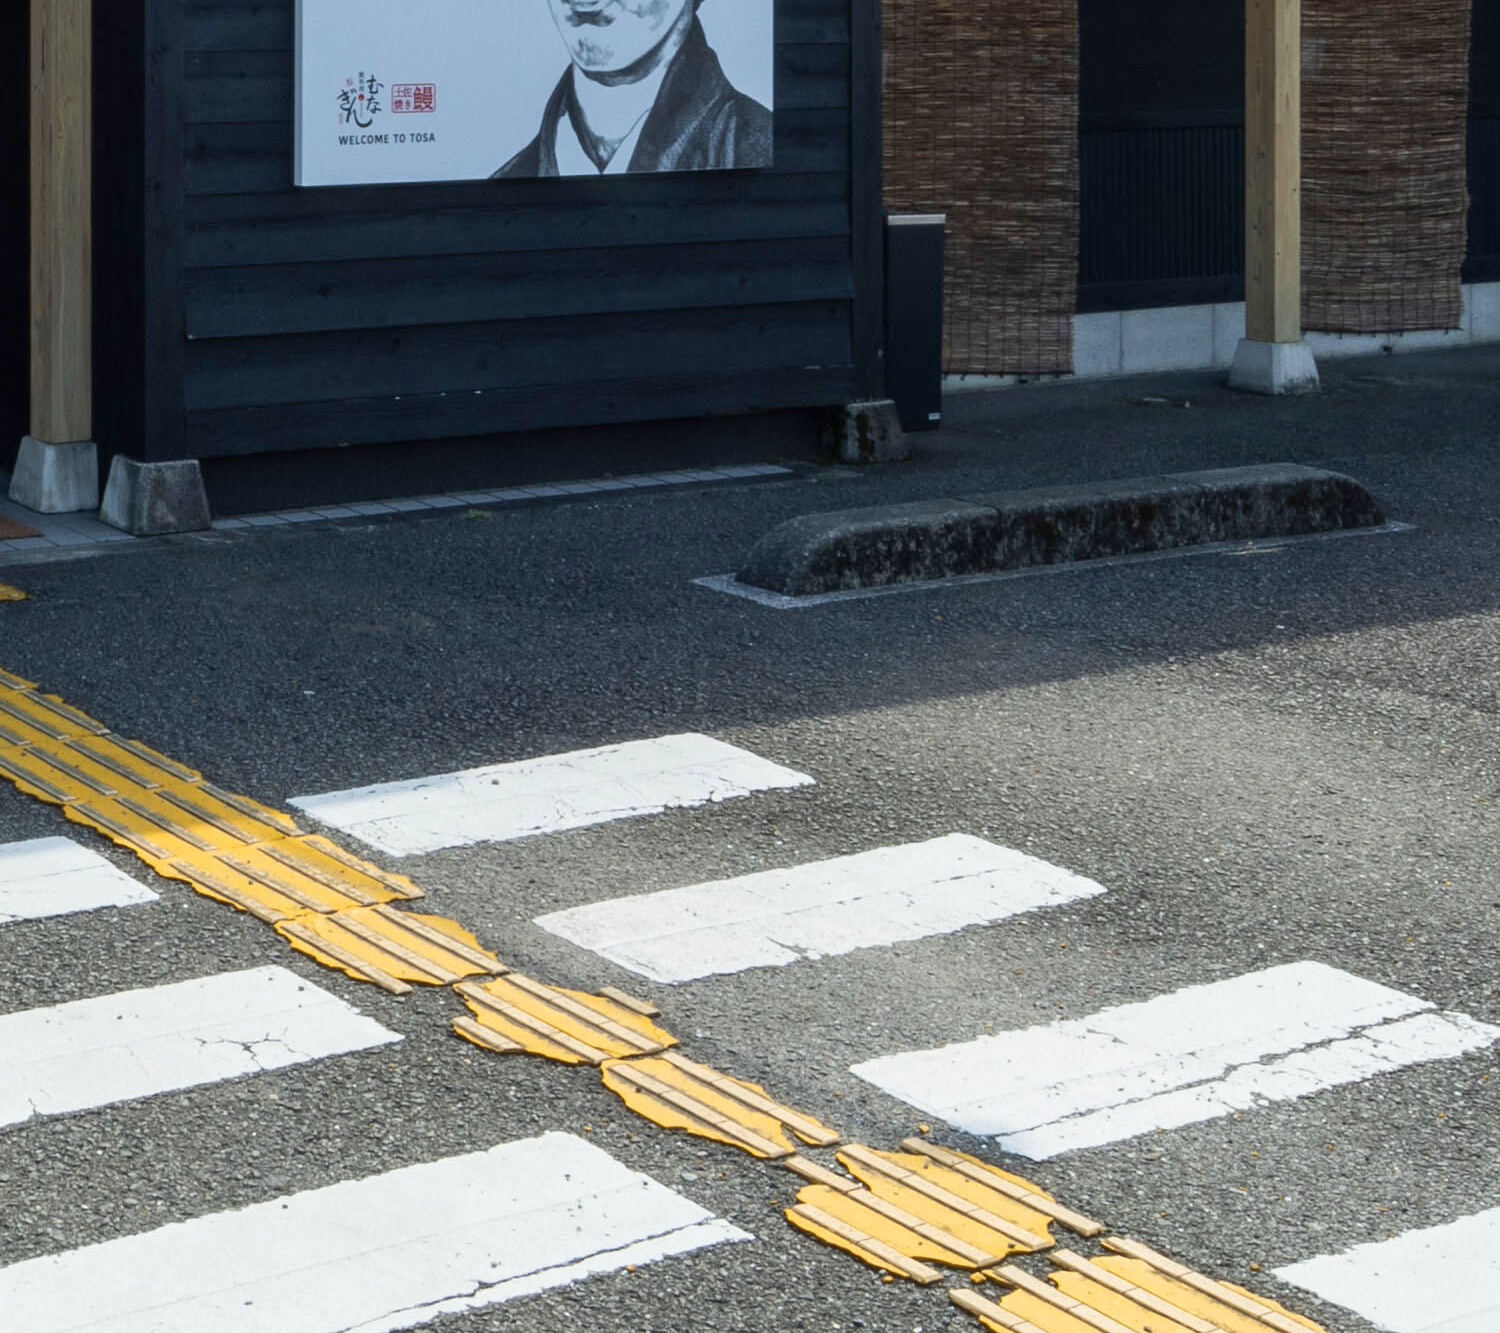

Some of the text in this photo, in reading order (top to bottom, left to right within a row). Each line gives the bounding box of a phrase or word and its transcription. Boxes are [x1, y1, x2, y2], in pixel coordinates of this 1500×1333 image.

[338, 132, 436, 146] WELCOME TO TOSA
